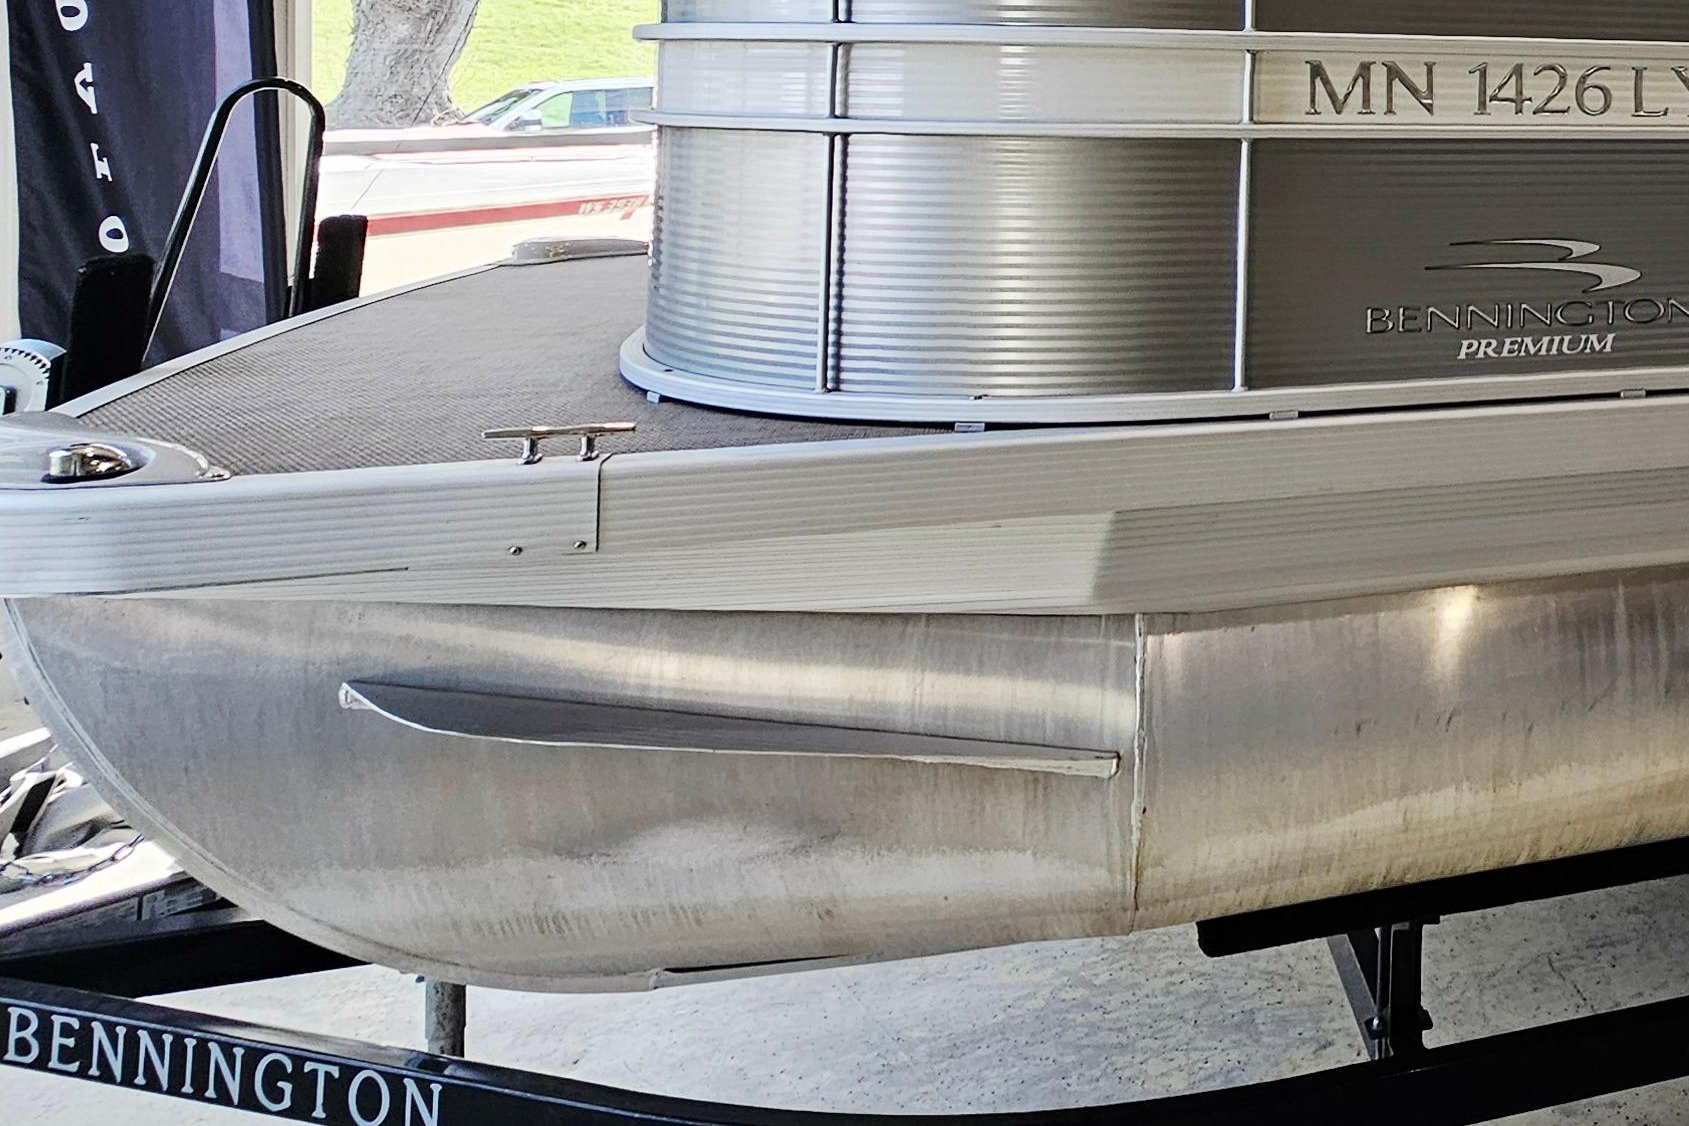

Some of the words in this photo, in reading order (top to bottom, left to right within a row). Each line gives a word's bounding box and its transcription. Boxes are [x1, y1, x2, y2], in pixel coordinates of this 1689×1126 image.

[1304, 59, 1437, 116] MN
[1456, 332, 1616, 360] PREMIUM
[3, 1006, 443, 1126] BENNINGTON
